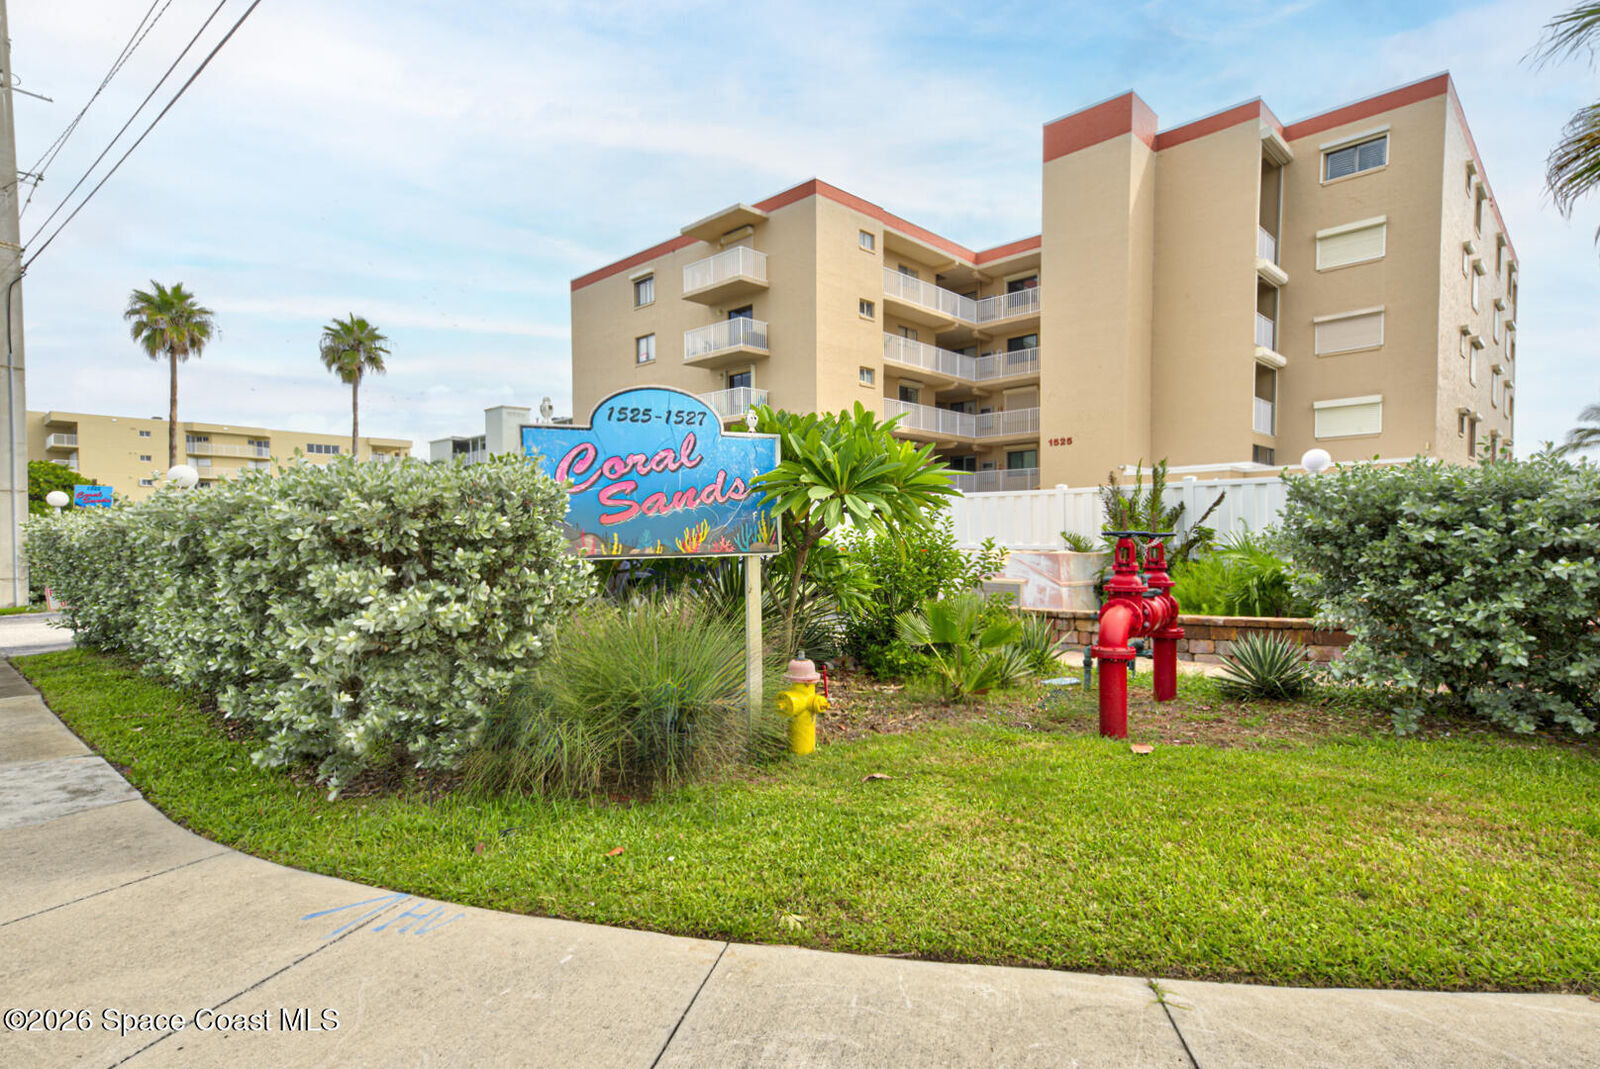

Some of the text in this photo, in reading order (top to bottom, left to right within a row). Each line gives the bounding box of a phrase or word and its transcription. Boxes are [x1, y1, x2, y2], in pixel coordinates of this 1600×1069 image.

[607, 406, 707, 426] 1525-1527
[1048, 437, 1073, 447] 1525
[554, 431, 703, 494] Coral
[598, 469, 752, 526] Sands
